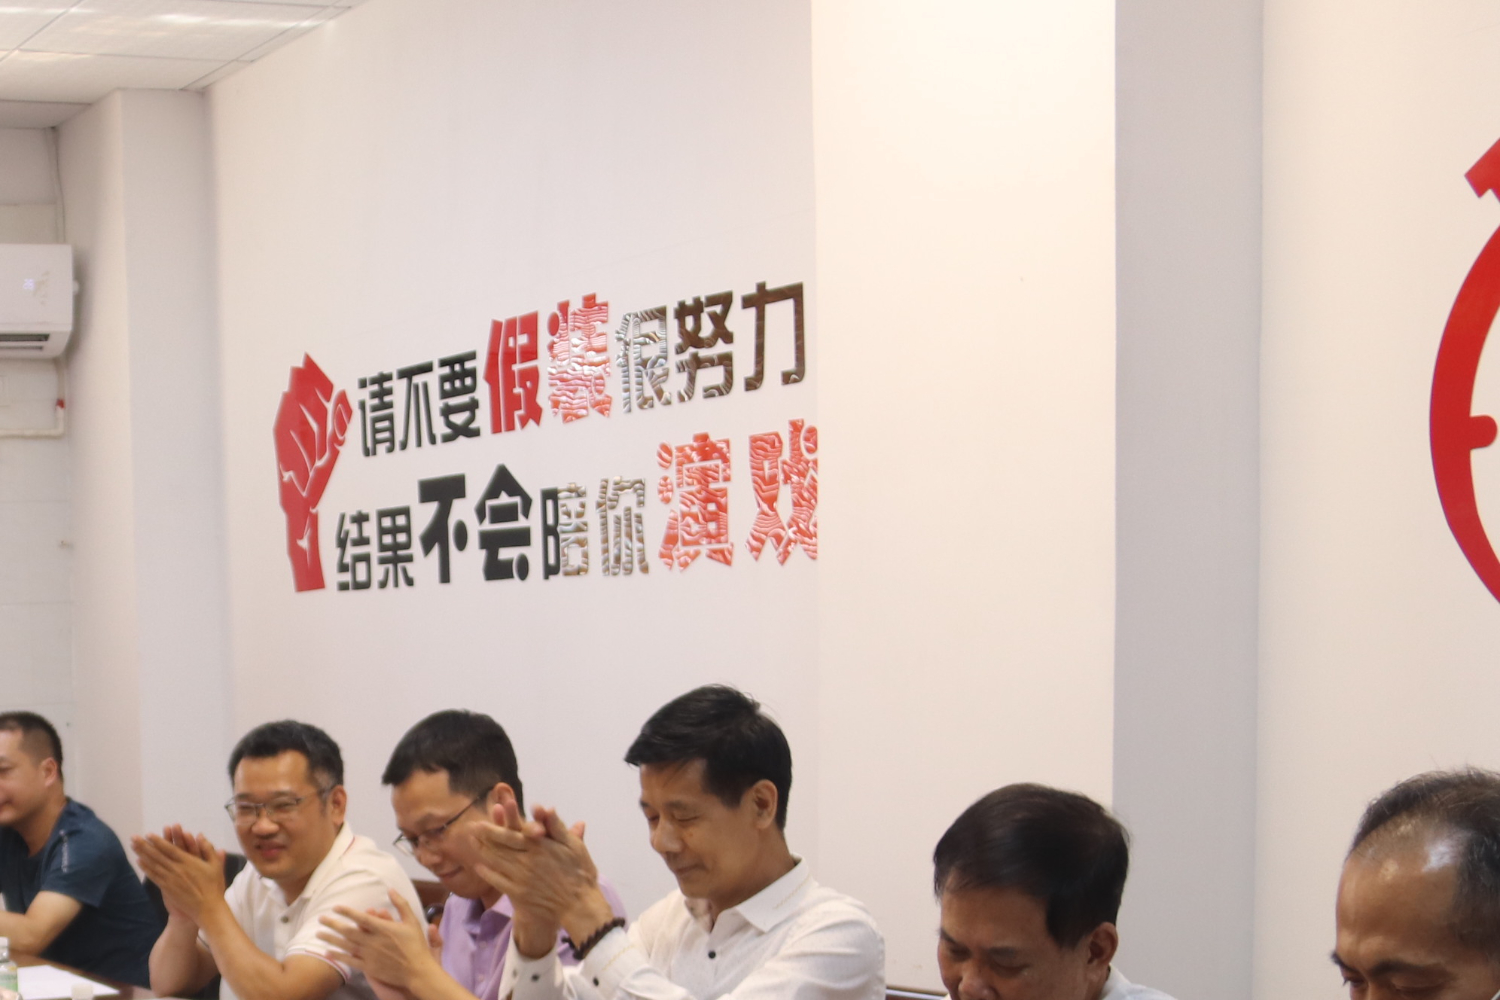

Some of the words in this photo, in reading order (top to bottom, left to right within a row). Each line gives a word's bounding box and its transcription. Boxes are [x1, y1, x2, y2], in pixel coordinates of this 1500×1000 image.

[357, 281, 806, 457] 请不要假装很努力
[336, 418, 819, 592] 结果不会陪你演戏
